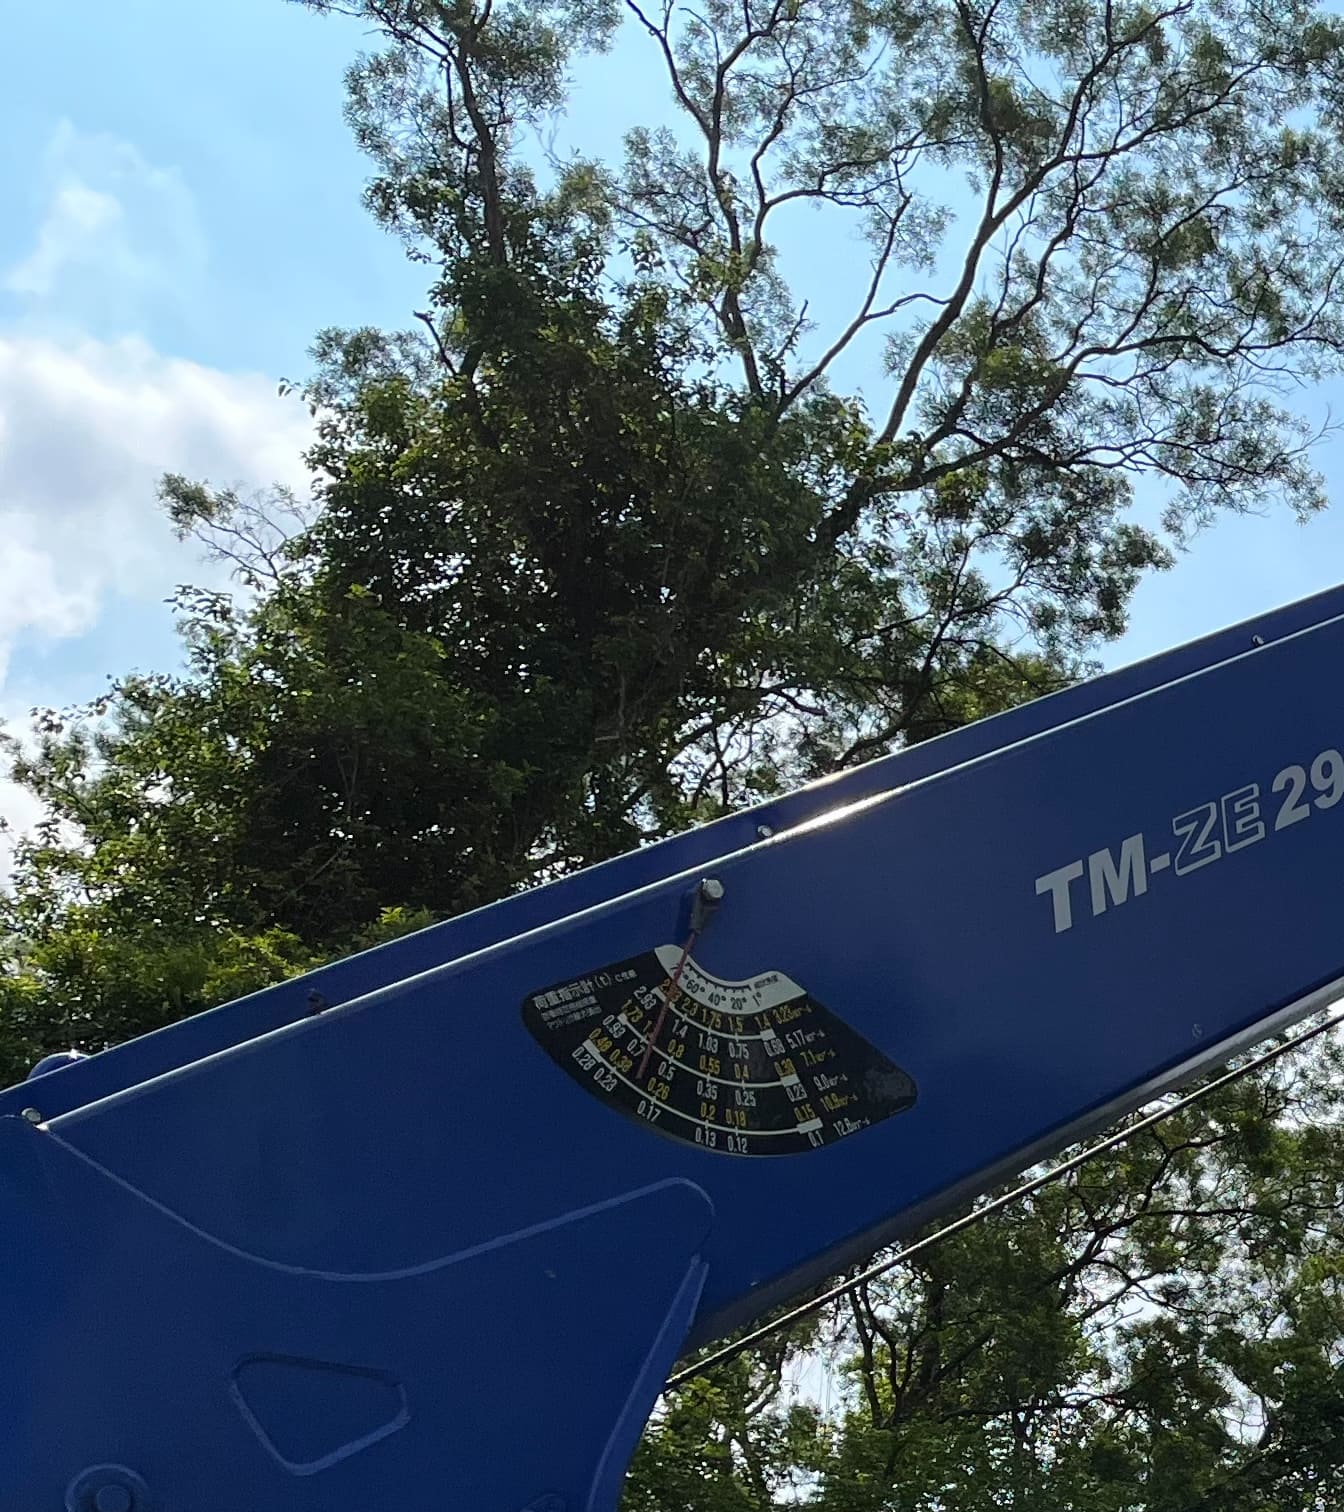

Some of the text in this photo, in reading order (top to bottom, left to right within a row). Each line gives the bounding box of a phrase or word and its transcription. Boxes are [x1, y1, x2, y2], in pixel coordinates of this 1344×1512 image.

[621, 1000, 645, 1024] 1.73
[733, 1062, 750, 1080] 0.4
[671, 1018, 689, 1039] 1.4
[698, 1033, 720, 1054] 1.03
[728, 1042, 750, 1060] 0.75
[702, 1009, 722, 1029] 1.75
[728, 1016, 744, 1033] 1.5
[754, 1013, 771, 1030] 1.4
[627, 1038, 646, 1057] 0.7
[657, 1061, 675, 1081] 0.5
[696, 1080, 717, 1100] 0.35
[735, 1089, 757, 1107] 0.25
[593, 1067, 619, 1093] 0.23
[636, 1100, 662, 1122] 0.17
[695, 1127, 716, 1147] 0.13
[727, 1135, 748, 1154] 0.12
[807, 1132, 825, 1148] 0.1
[699, 1102, 717, 1120] 0.2
